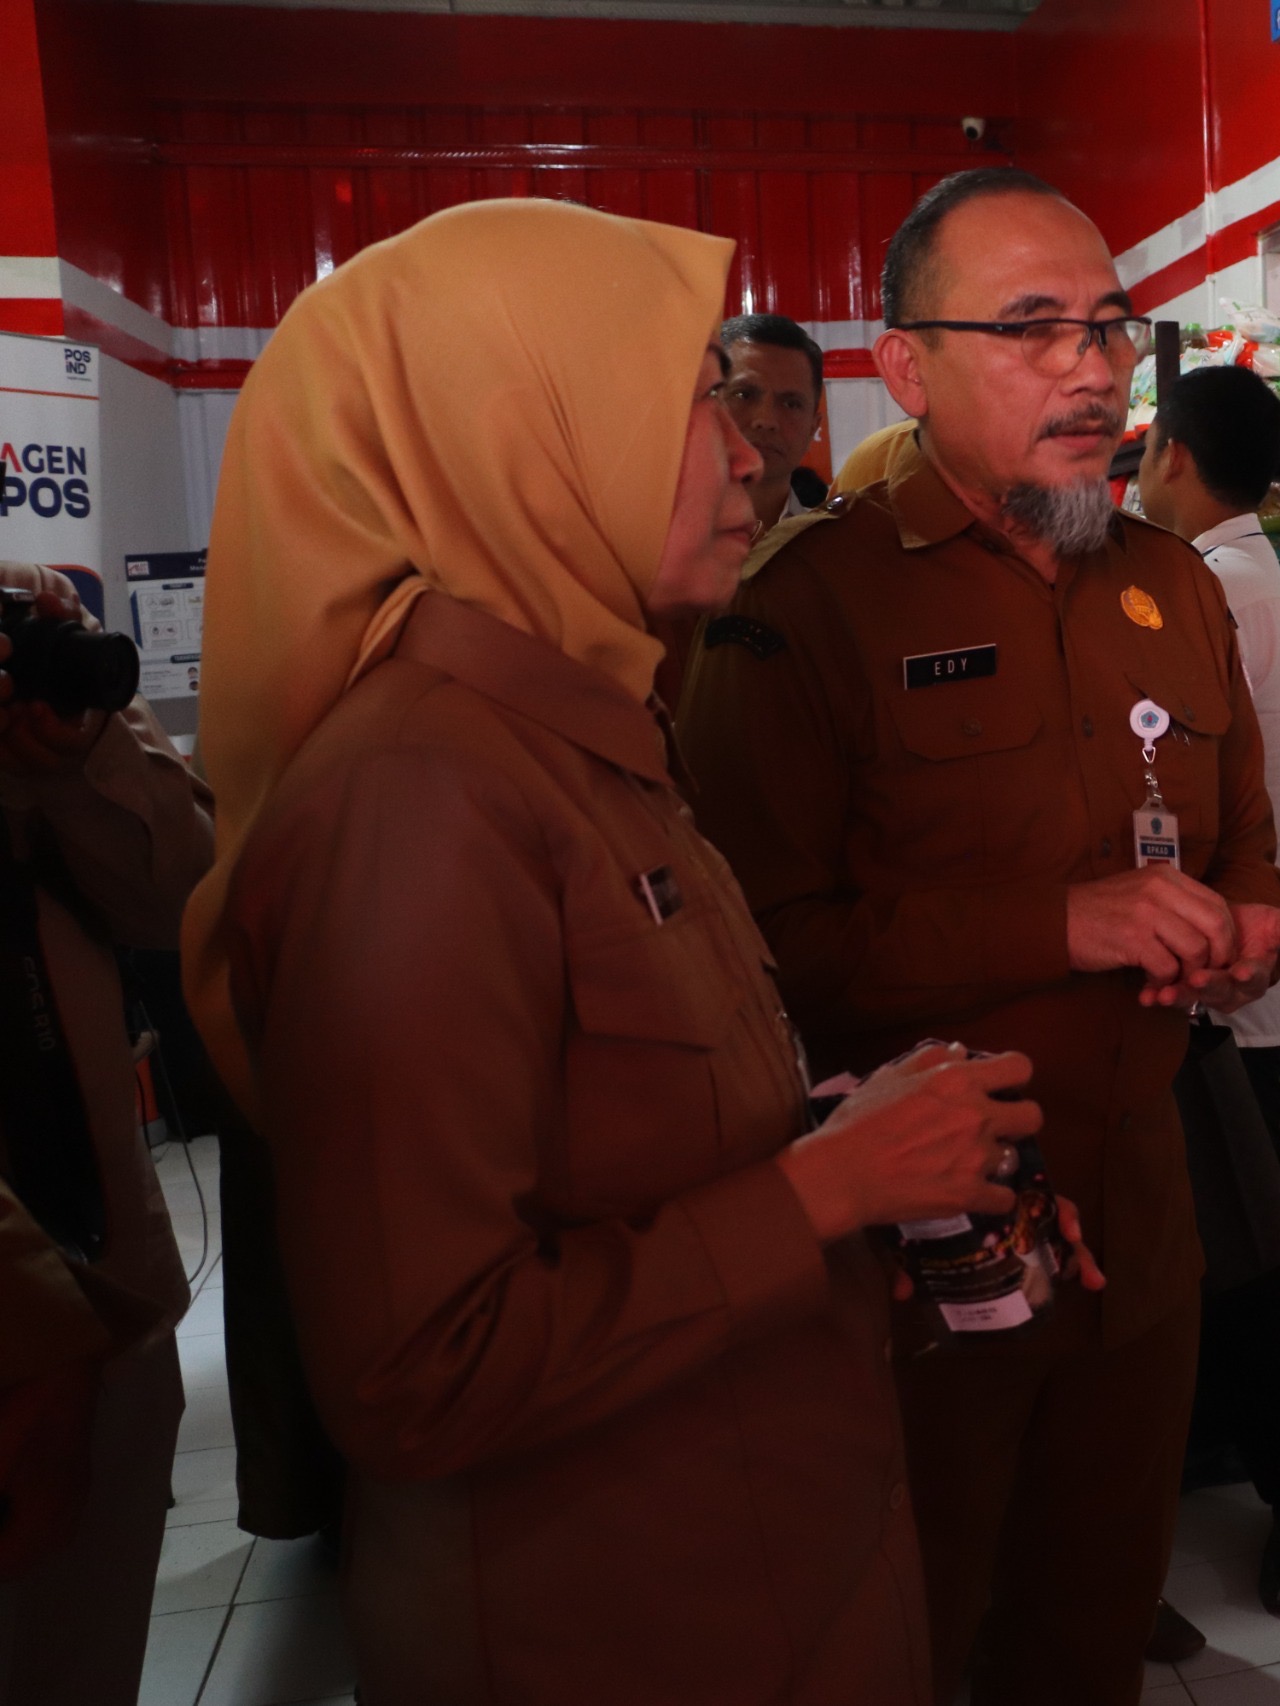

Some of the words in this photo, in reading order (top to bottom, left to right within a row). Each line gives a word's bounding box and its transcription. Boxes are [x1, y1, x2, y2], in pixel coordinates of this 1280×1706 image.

[64, 348, 91, 363] POS
[0, 477, 91, 519] POS
[935, 658, 968, 676] EDY
